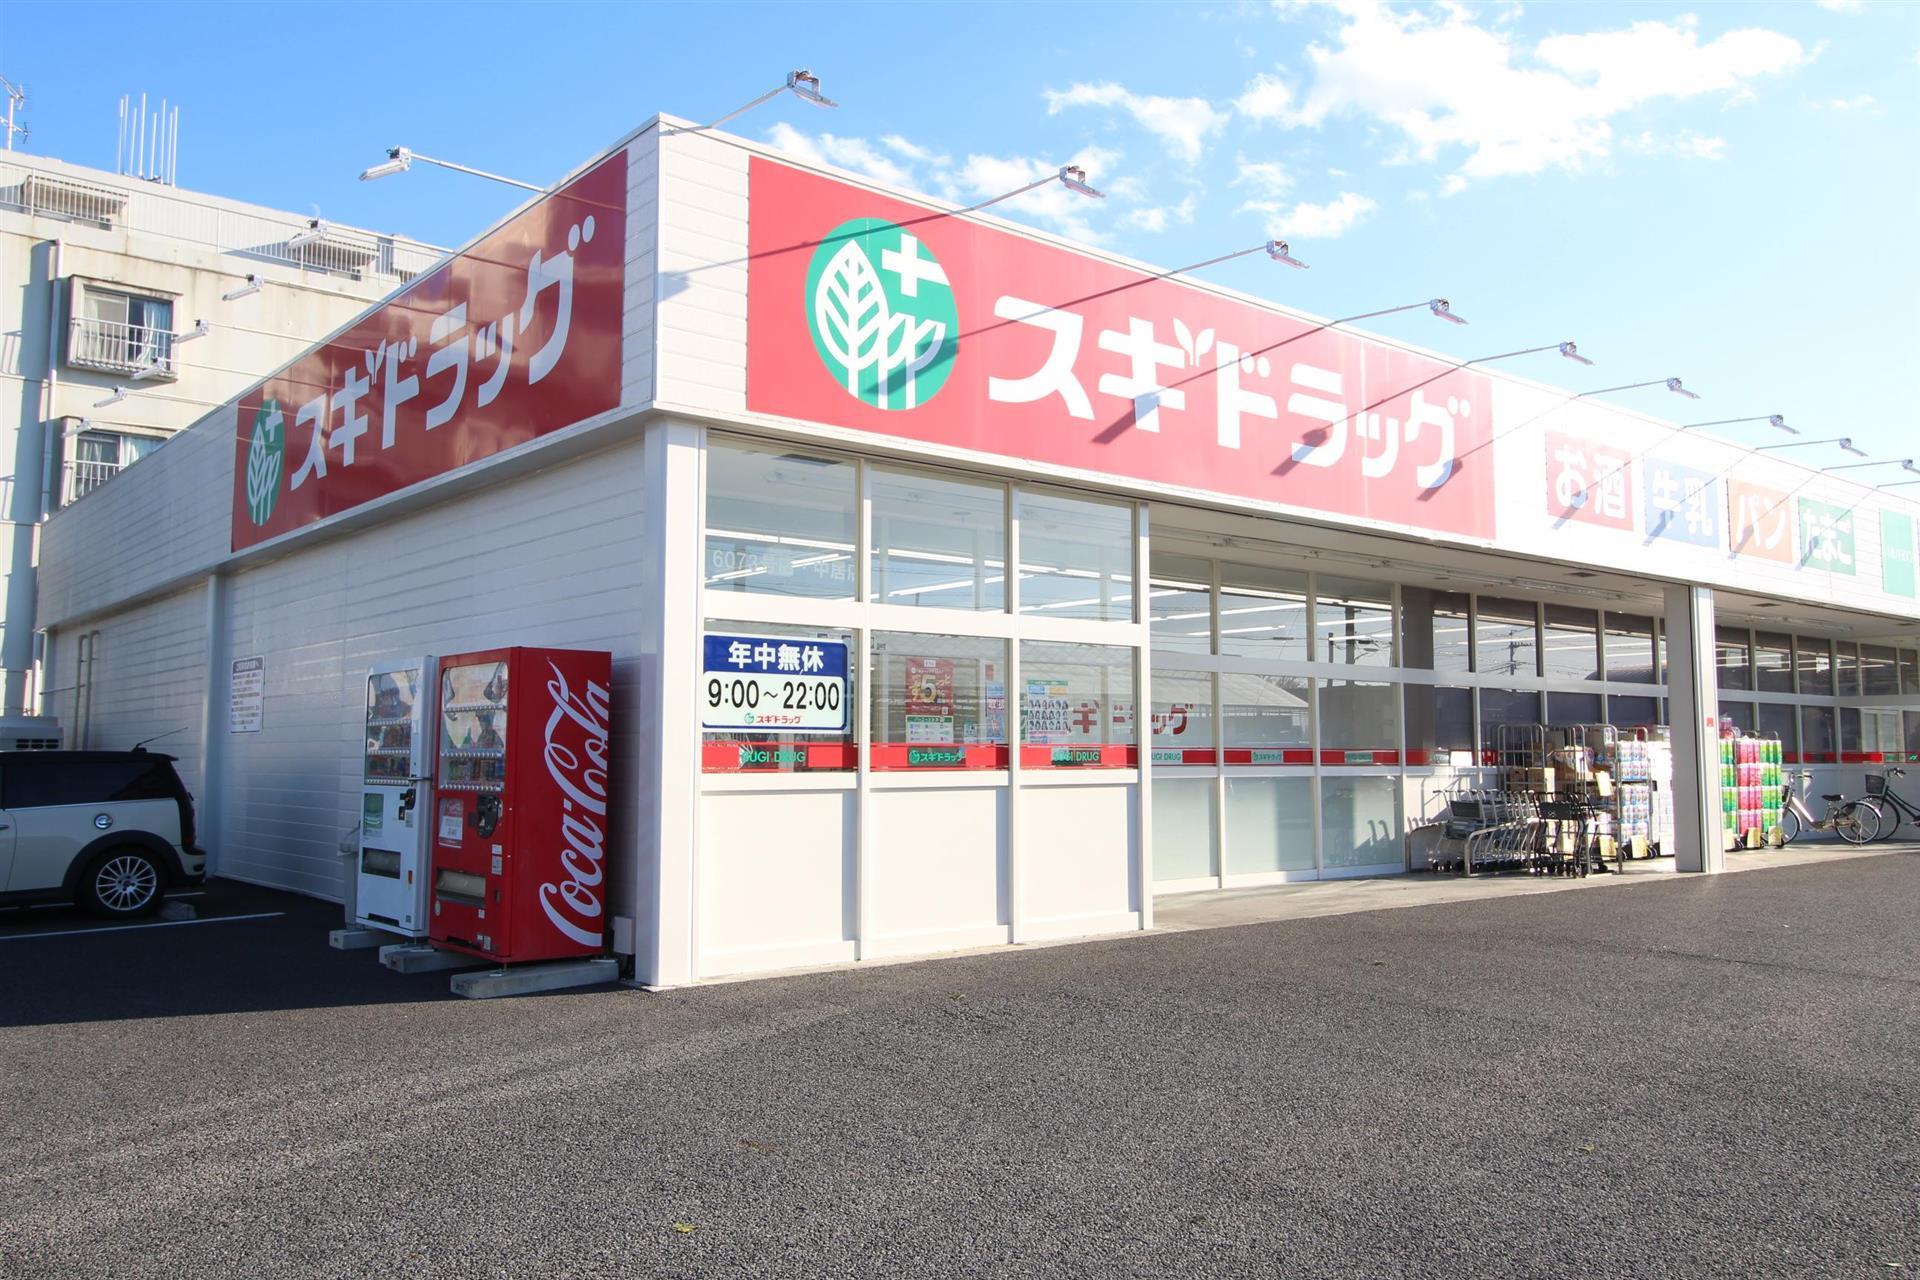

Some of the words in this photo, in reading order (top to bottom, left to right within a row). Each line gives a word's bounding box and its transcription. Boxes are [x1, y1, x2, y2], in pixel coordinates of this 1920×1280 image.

[290, 215, 595, 490] スギドラッグ
[988, 294, 1471, 490] スギドラッグ
[1554, 443, 1626, 519] お酒
[1652, 468, 1713, 537] 牛乳
[1736, 493, 1786, 551] パン
[728, 641, 824, 673] 年中無休
[756, 715, 801, 725] スギドラッグ
[1076, 750, 1100, 761] DRUG
[1164, 752, 1182, 761] DRUG
[539, 656, 610, 947] Coca-Cola
